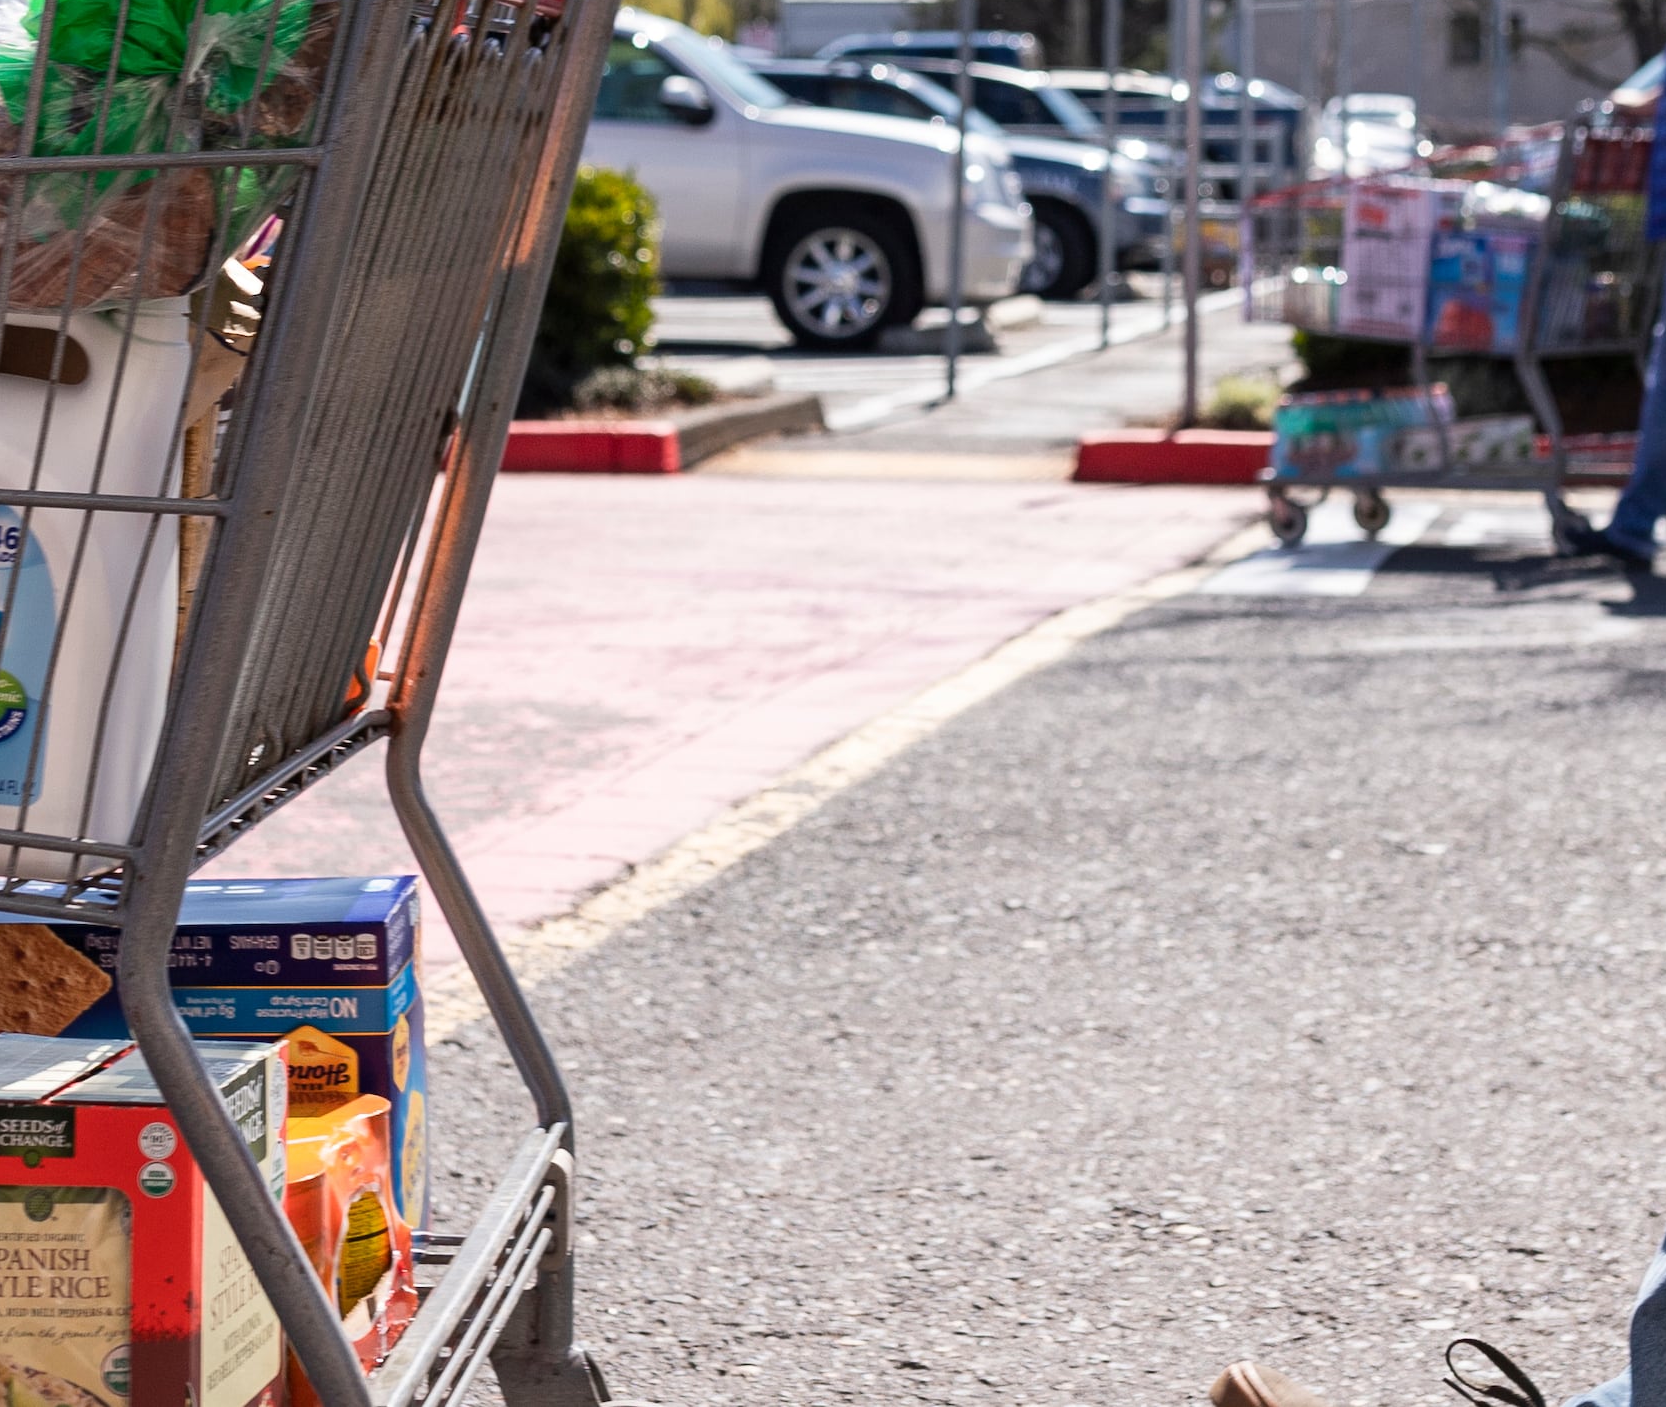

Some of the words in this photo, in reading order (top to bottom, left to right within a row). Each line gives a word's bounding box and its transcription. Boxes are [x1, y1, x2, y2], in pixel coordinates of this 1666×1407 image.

[329, 997, 359, 1019] NO
[288, 1063, 351, 1086] Hone
[52, 1119, 68, 1134] of
[49, 1276, 112, 1300] RICE
